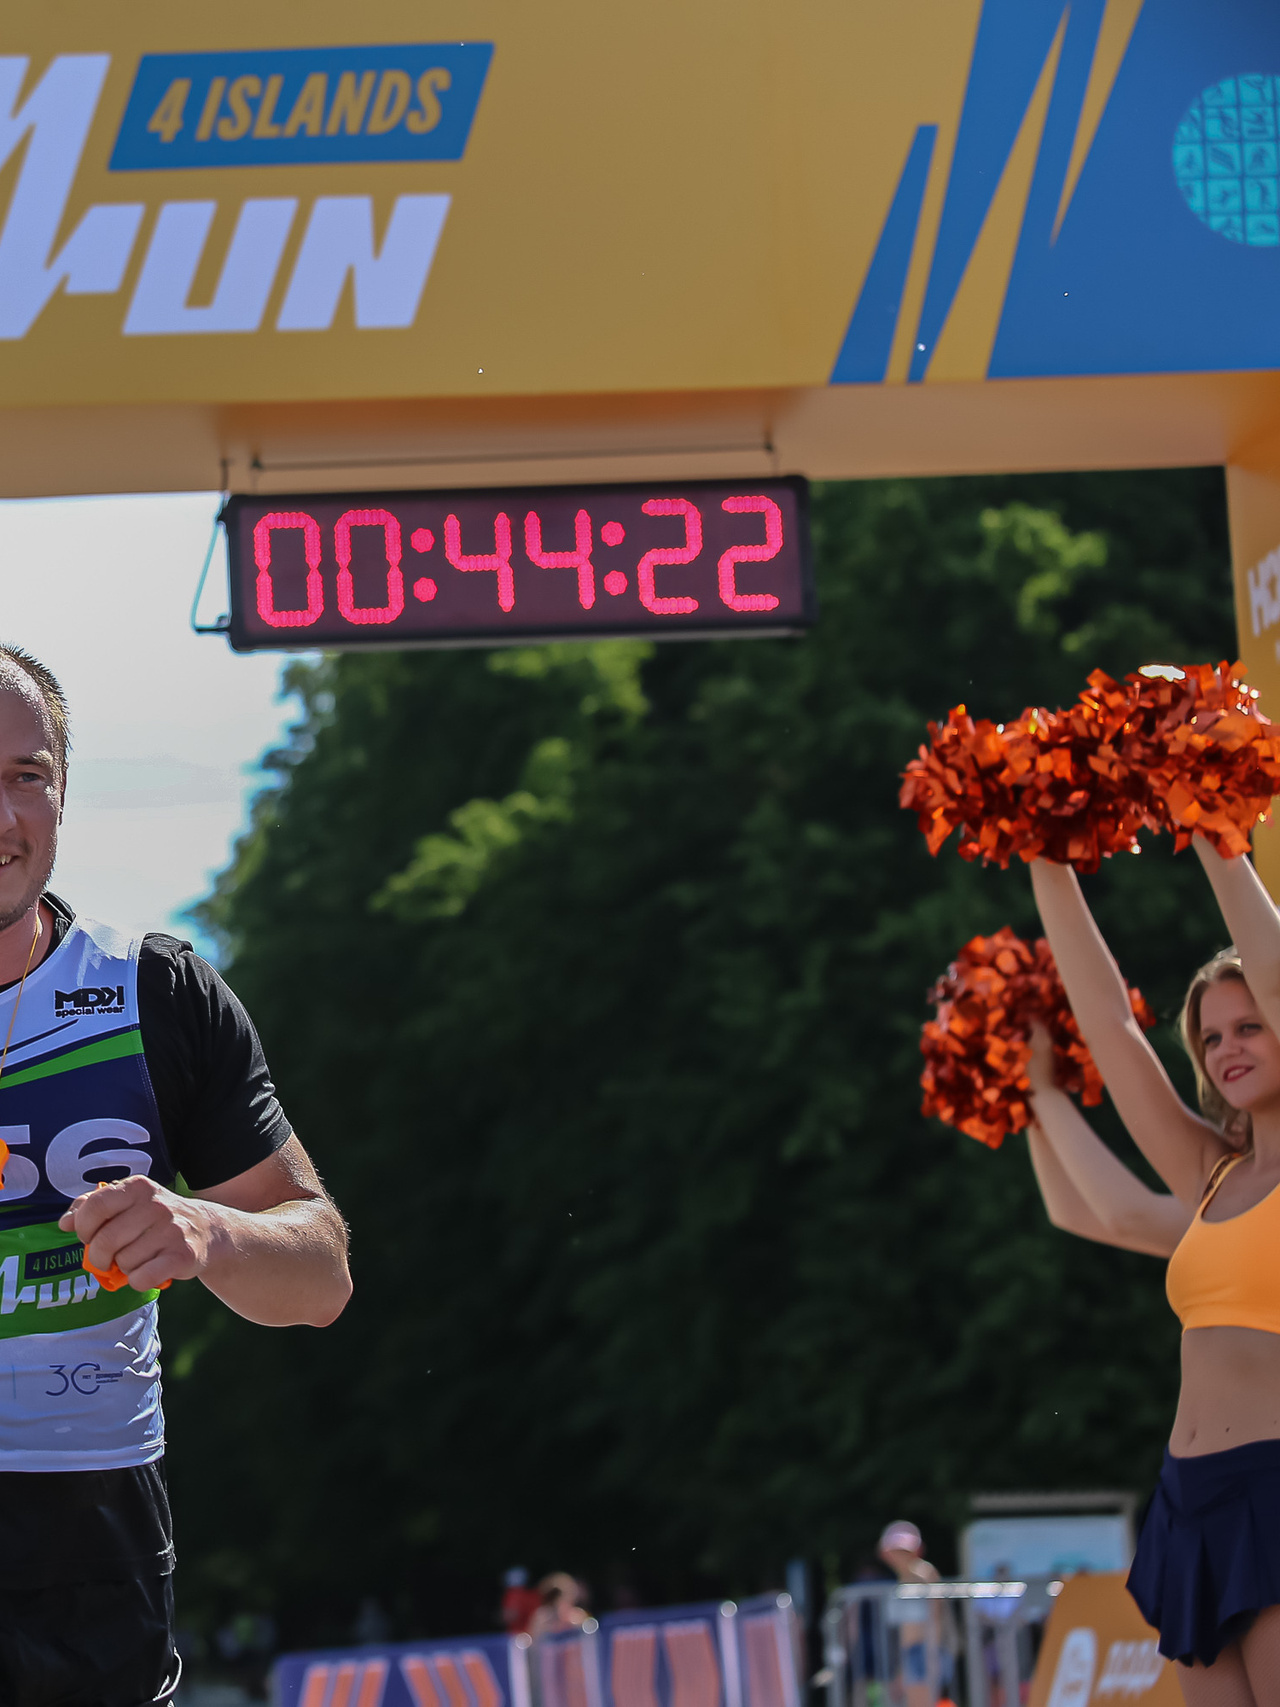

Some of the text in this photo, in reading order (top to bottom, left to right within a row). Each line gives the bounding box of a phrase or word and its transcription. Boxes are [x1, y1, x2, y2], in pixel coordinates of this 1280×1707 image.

[146, 66, 451, 143] 4 ISLANDS
[253, 495, 783, 627] 00:44:22
[55, 1006, 126, 1018] special wear
[32, 1258, 41, 1272] 4
